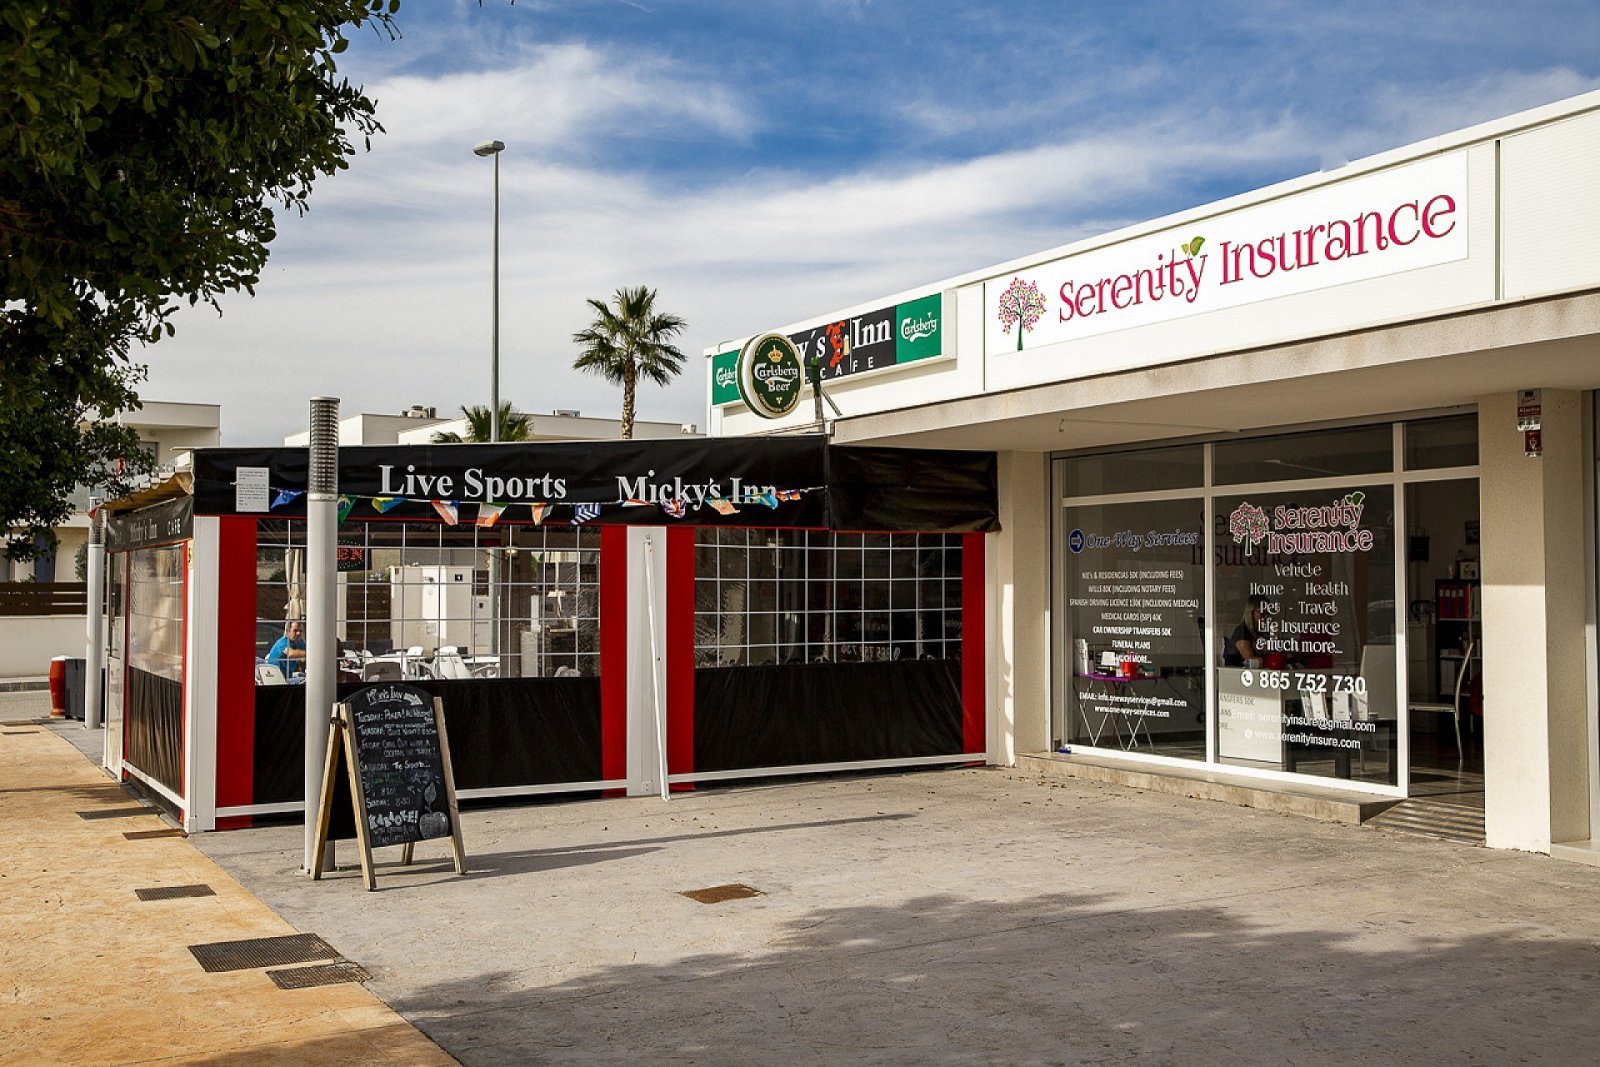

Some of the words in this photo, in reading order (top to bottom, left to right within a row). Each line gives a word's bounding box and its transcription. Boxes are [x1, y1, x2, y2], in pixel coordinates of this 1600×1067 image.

[1059, 240, 1208, 323] Serenity
[1219, 194, 1456, 286] Insurance
[852, 317, 892, 349] Inn
[901, 312, 938, 342] Carlsberg
[716, 364, 737, 388] Carlsbe
[754, 361, 799, 381] Carlsberg
[767, 381, 791, 392] Beer
[378, 464, 453, 496] Live
[464, 468, 567, 504] Sports
[615, 469, 721, 511] Micky's
[1274, 499, 1364, 530] Serenity
[1145, 528, 1199, 548] Services
[1267, 529, 1374, 555] Insurance
[1169, 570, 1184, 580] FEES)
[1274, 562, 1322, 578] Vehicle
[1141, 585, 1161, 593] NOTARY
[1162, 585, 1176, 594] FEES)
[1249, 582, 1284, 595] Home
[1305, 581, 1349, 596] Health
[1173, 599, 1199, 609] MEDICAL)
[1260, 601, 1280, 615] Pet
[1298, 600, 1338, 616] Travel
[1101, 612, 1122, 620] MEDICAL
[1092, 626, 1103, 634] CAR
[1103, 626, 1132, 635] OWNERSHIP
[1133, 627, 1161, 636] TRANSFERS
[1258, 617, 1279, 633] Life
[1281, 619, 1340, 636] Insurance
[1112, 640, 1134, 649] FUNERAL
[1135, 641, 1151, 649] PLANS
[1267, 637, 1299, 653] much
[1259, 670, 1291, 690] 865
[1295, 672, 1327, 692] 752
[1332, 675, 1366, 695] 730
